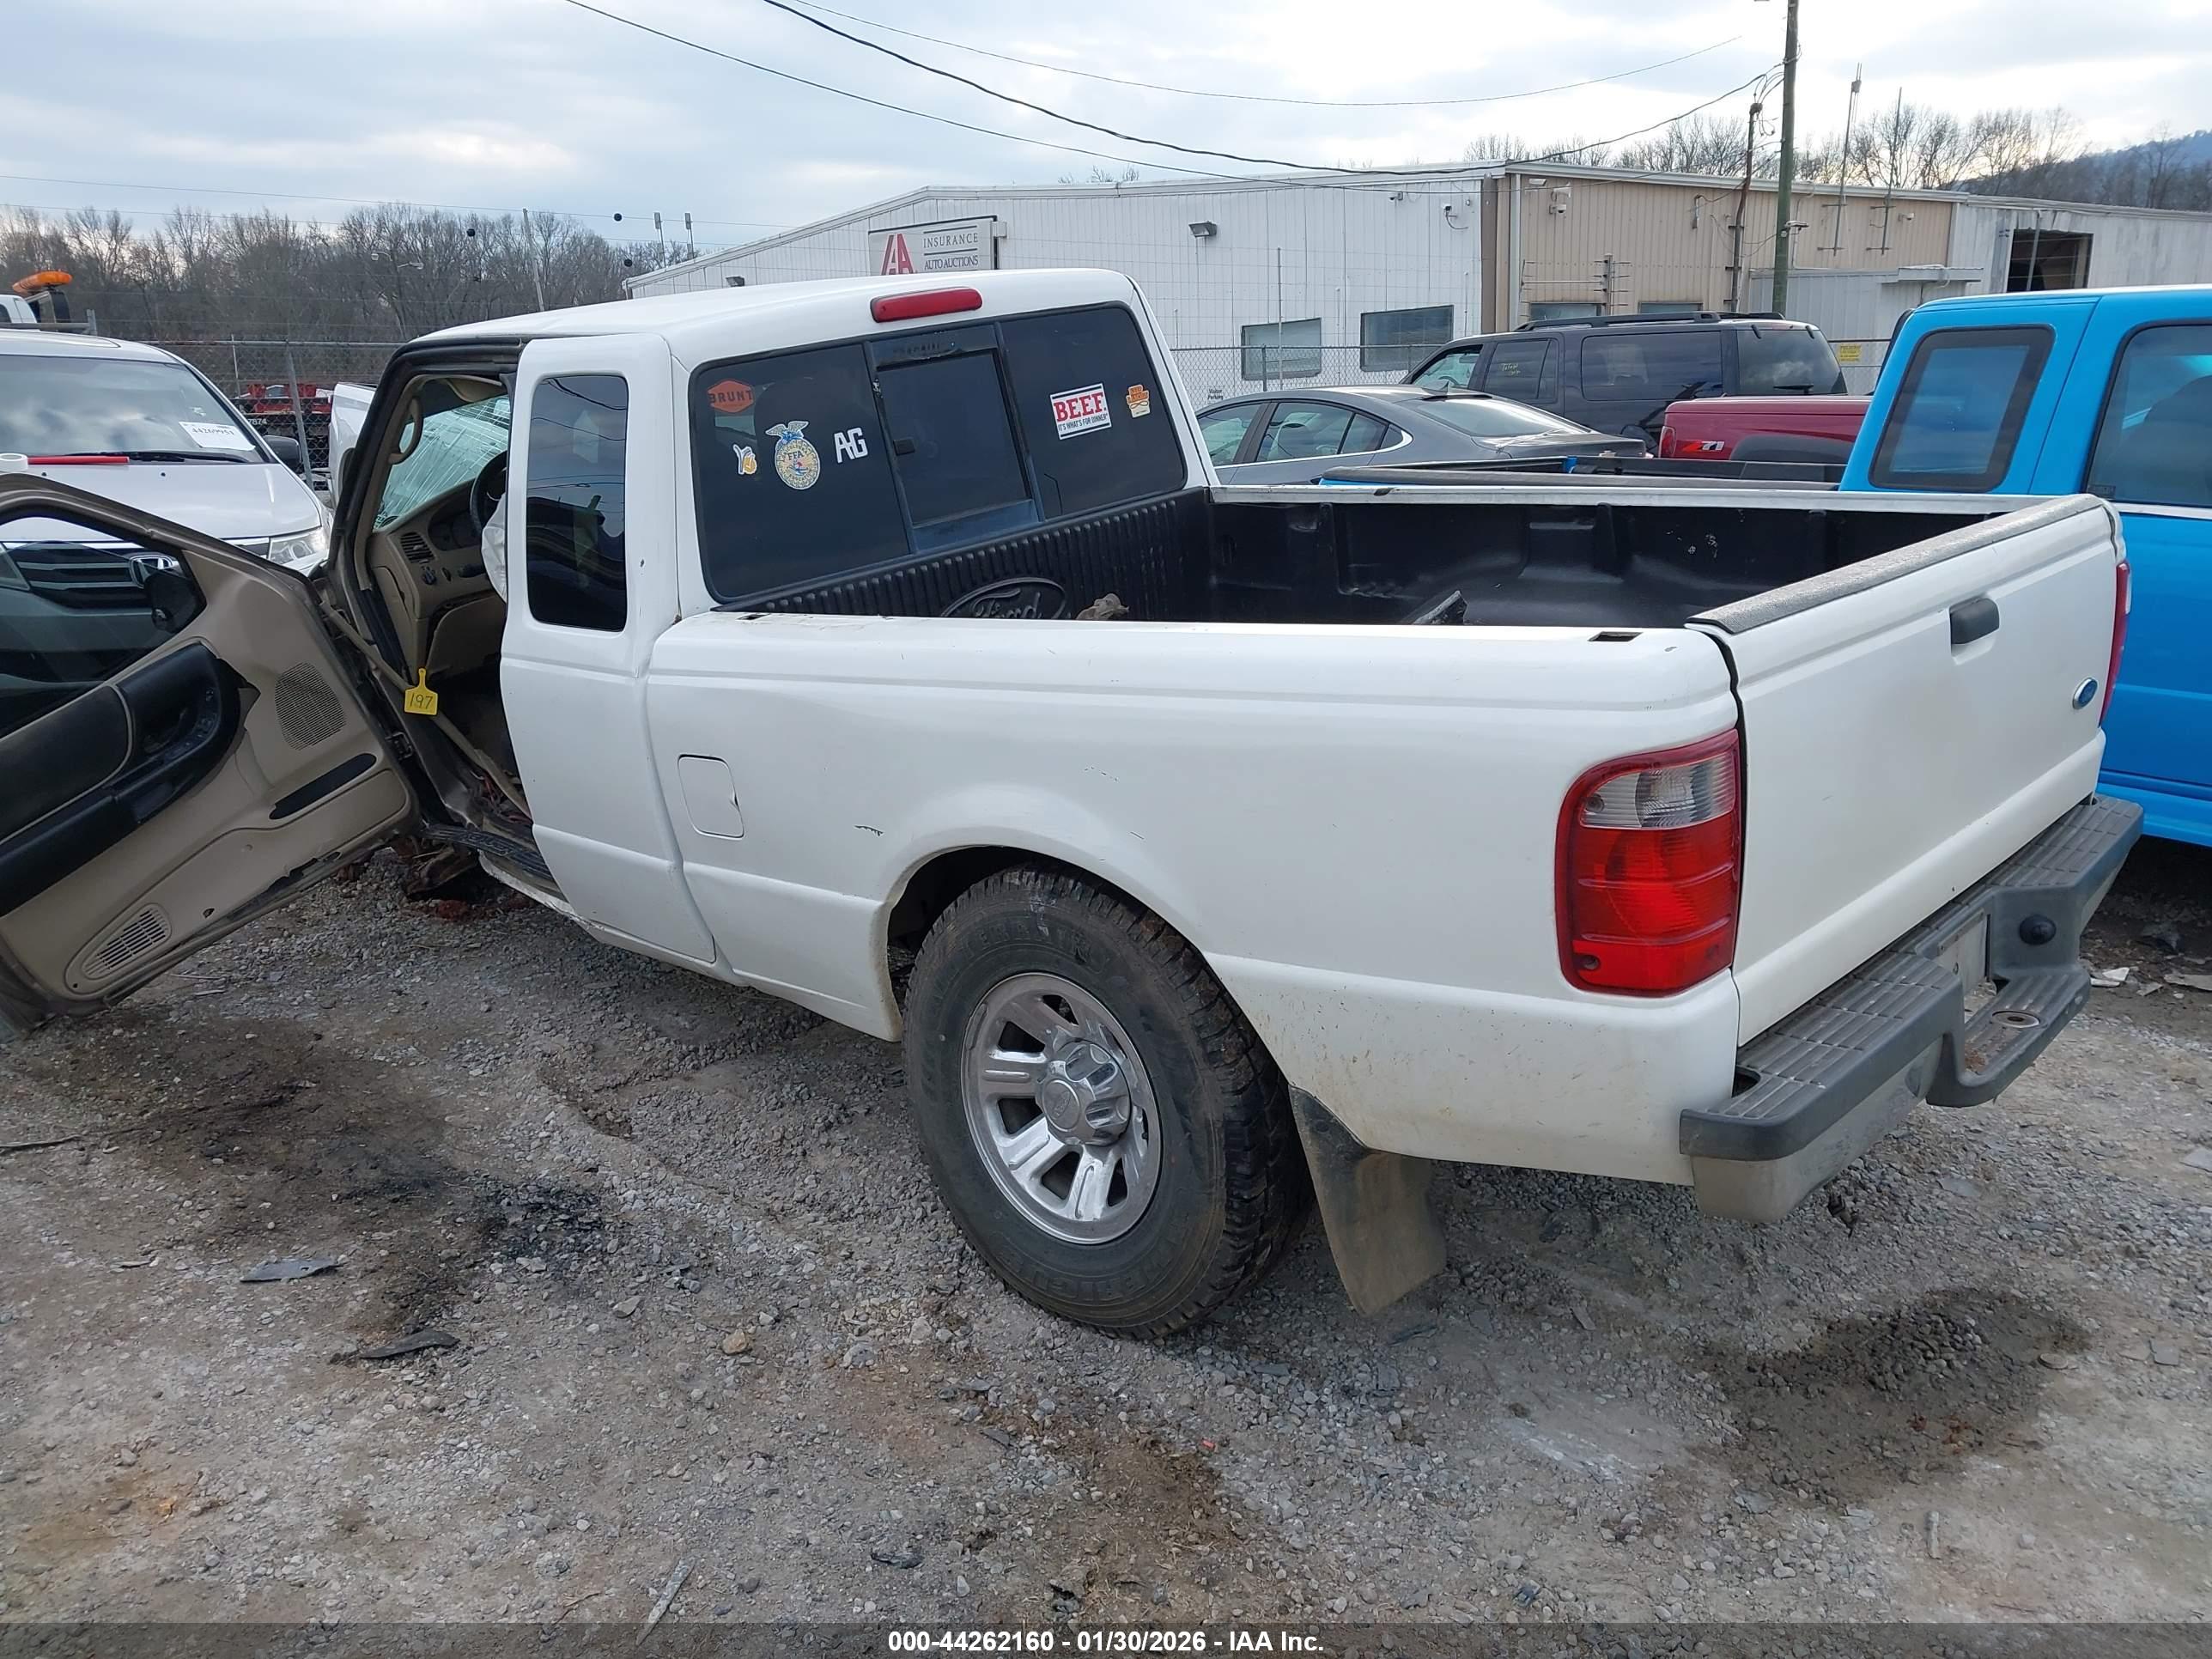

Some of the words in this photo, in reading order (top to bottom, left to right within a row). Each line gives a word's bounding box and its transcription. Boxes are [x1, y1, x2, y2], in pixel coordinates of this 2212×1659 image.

[923, 232, 979, 248] INSURANCE
[924, 258, 944, 270] AUTO
[944, 254, 979, 269] AUCTIONS
[707, 390, 753, 404] BRUNT
[1066, 419, 1083, 429] WHAT'S
[1082, 416, 1091, 427] FOR
[833, 427, 869, 464] AG
[1681, 440, 1725, 453] Z71
[787, 450, 805, 461] FFA
[410, 692, 434, 710] 197
